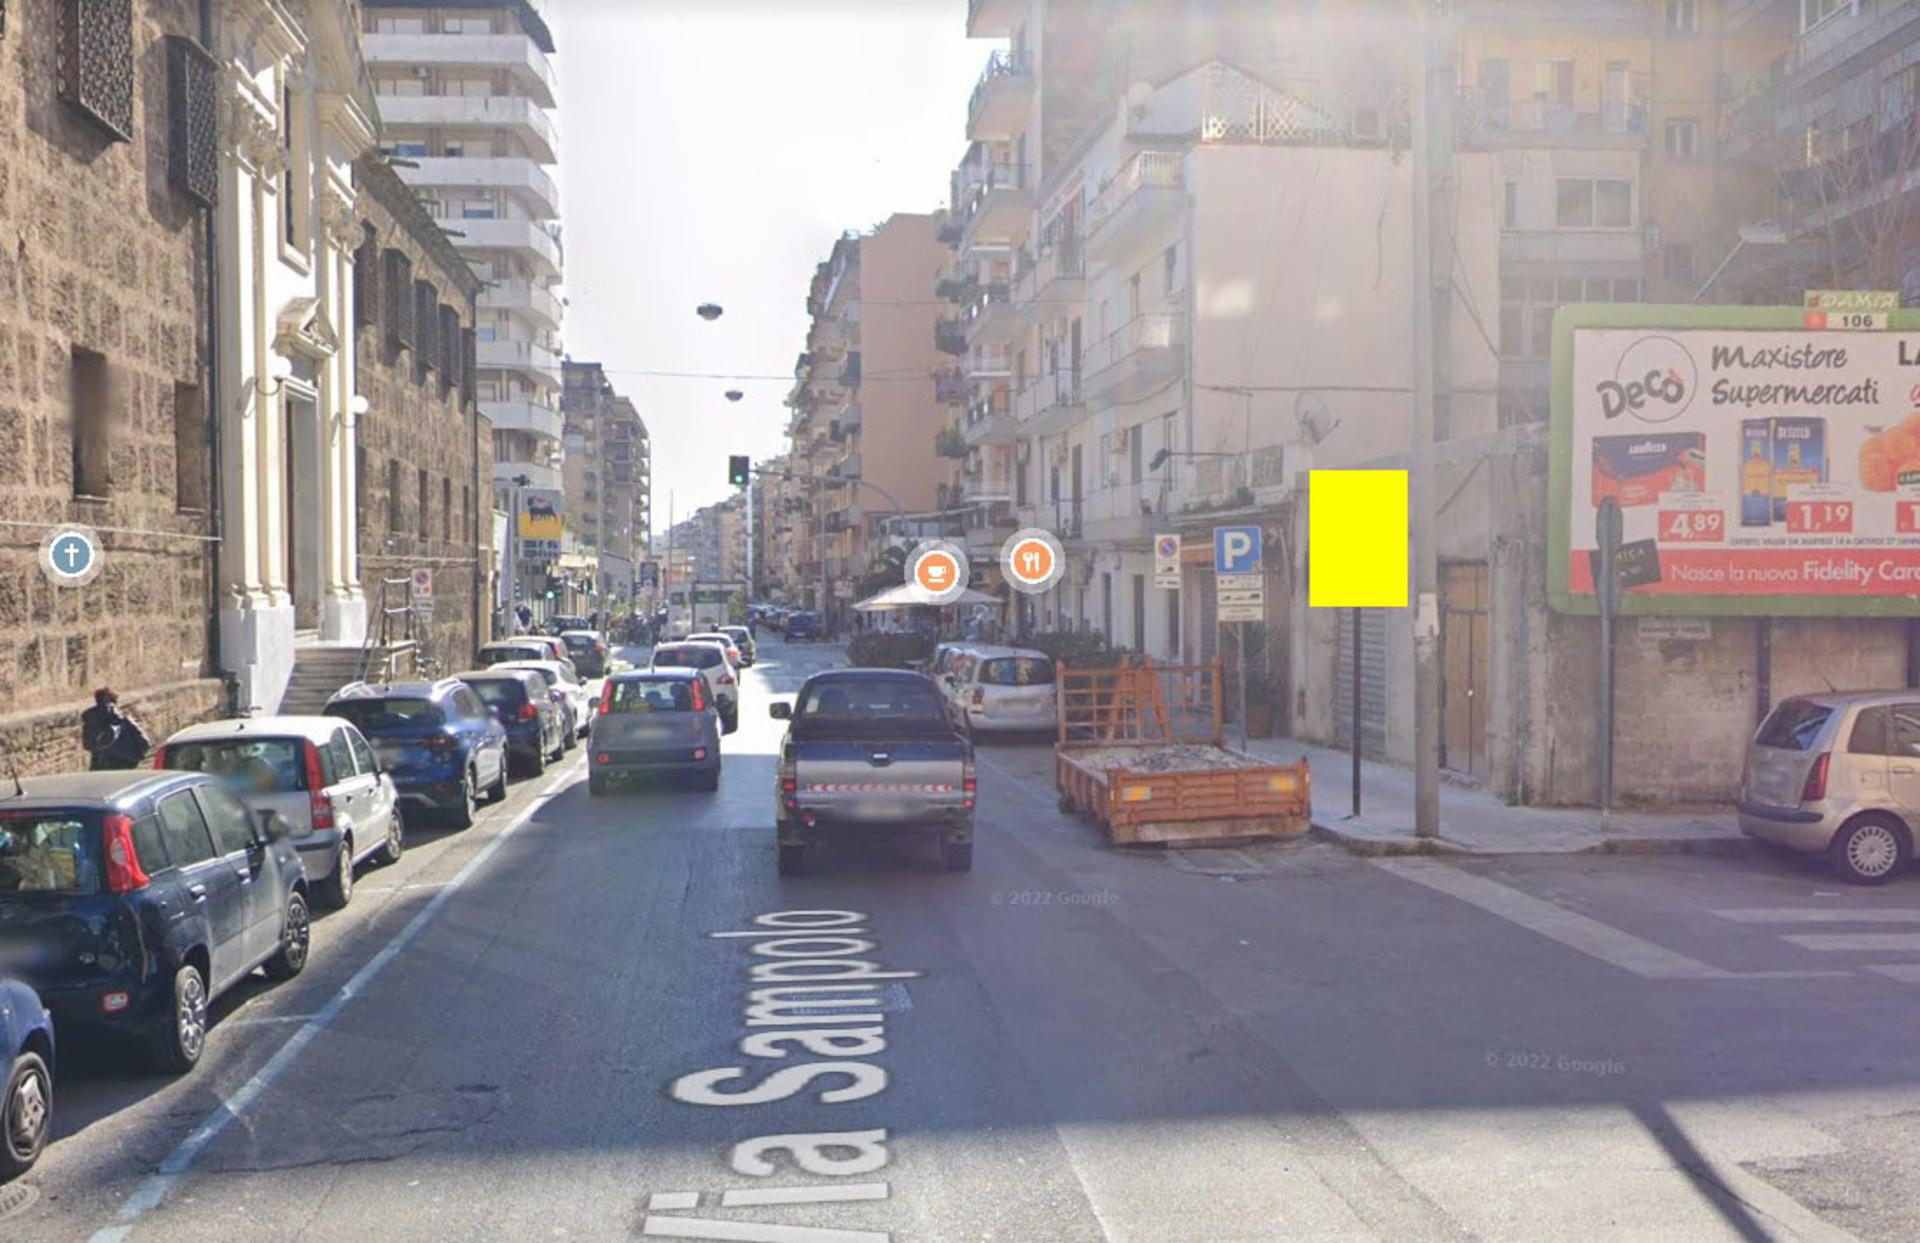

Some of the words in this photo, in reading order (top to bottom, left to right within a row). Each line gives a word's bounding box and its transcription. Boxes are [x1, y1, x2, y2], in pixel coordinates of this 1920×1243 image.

[1841, 314, 1874, 327] 106
[1710, 344, 1848, 373] Maxistore
[1595, 366, 1686, 420] Decò
[1710, 376, 1880, 409] Supermercati
[1669, 512, 1720, 540] 4,89
[1800, 504, 1850, 531] 1,19
[1223, 531, 1252, 569] P
[1670, 564, 1725, 581] Nasce
[1729, 561, 1744, 581] la
[1748, 568, 1798, 581] nuova
[1803, 559, 1873, 587] Fidelity
